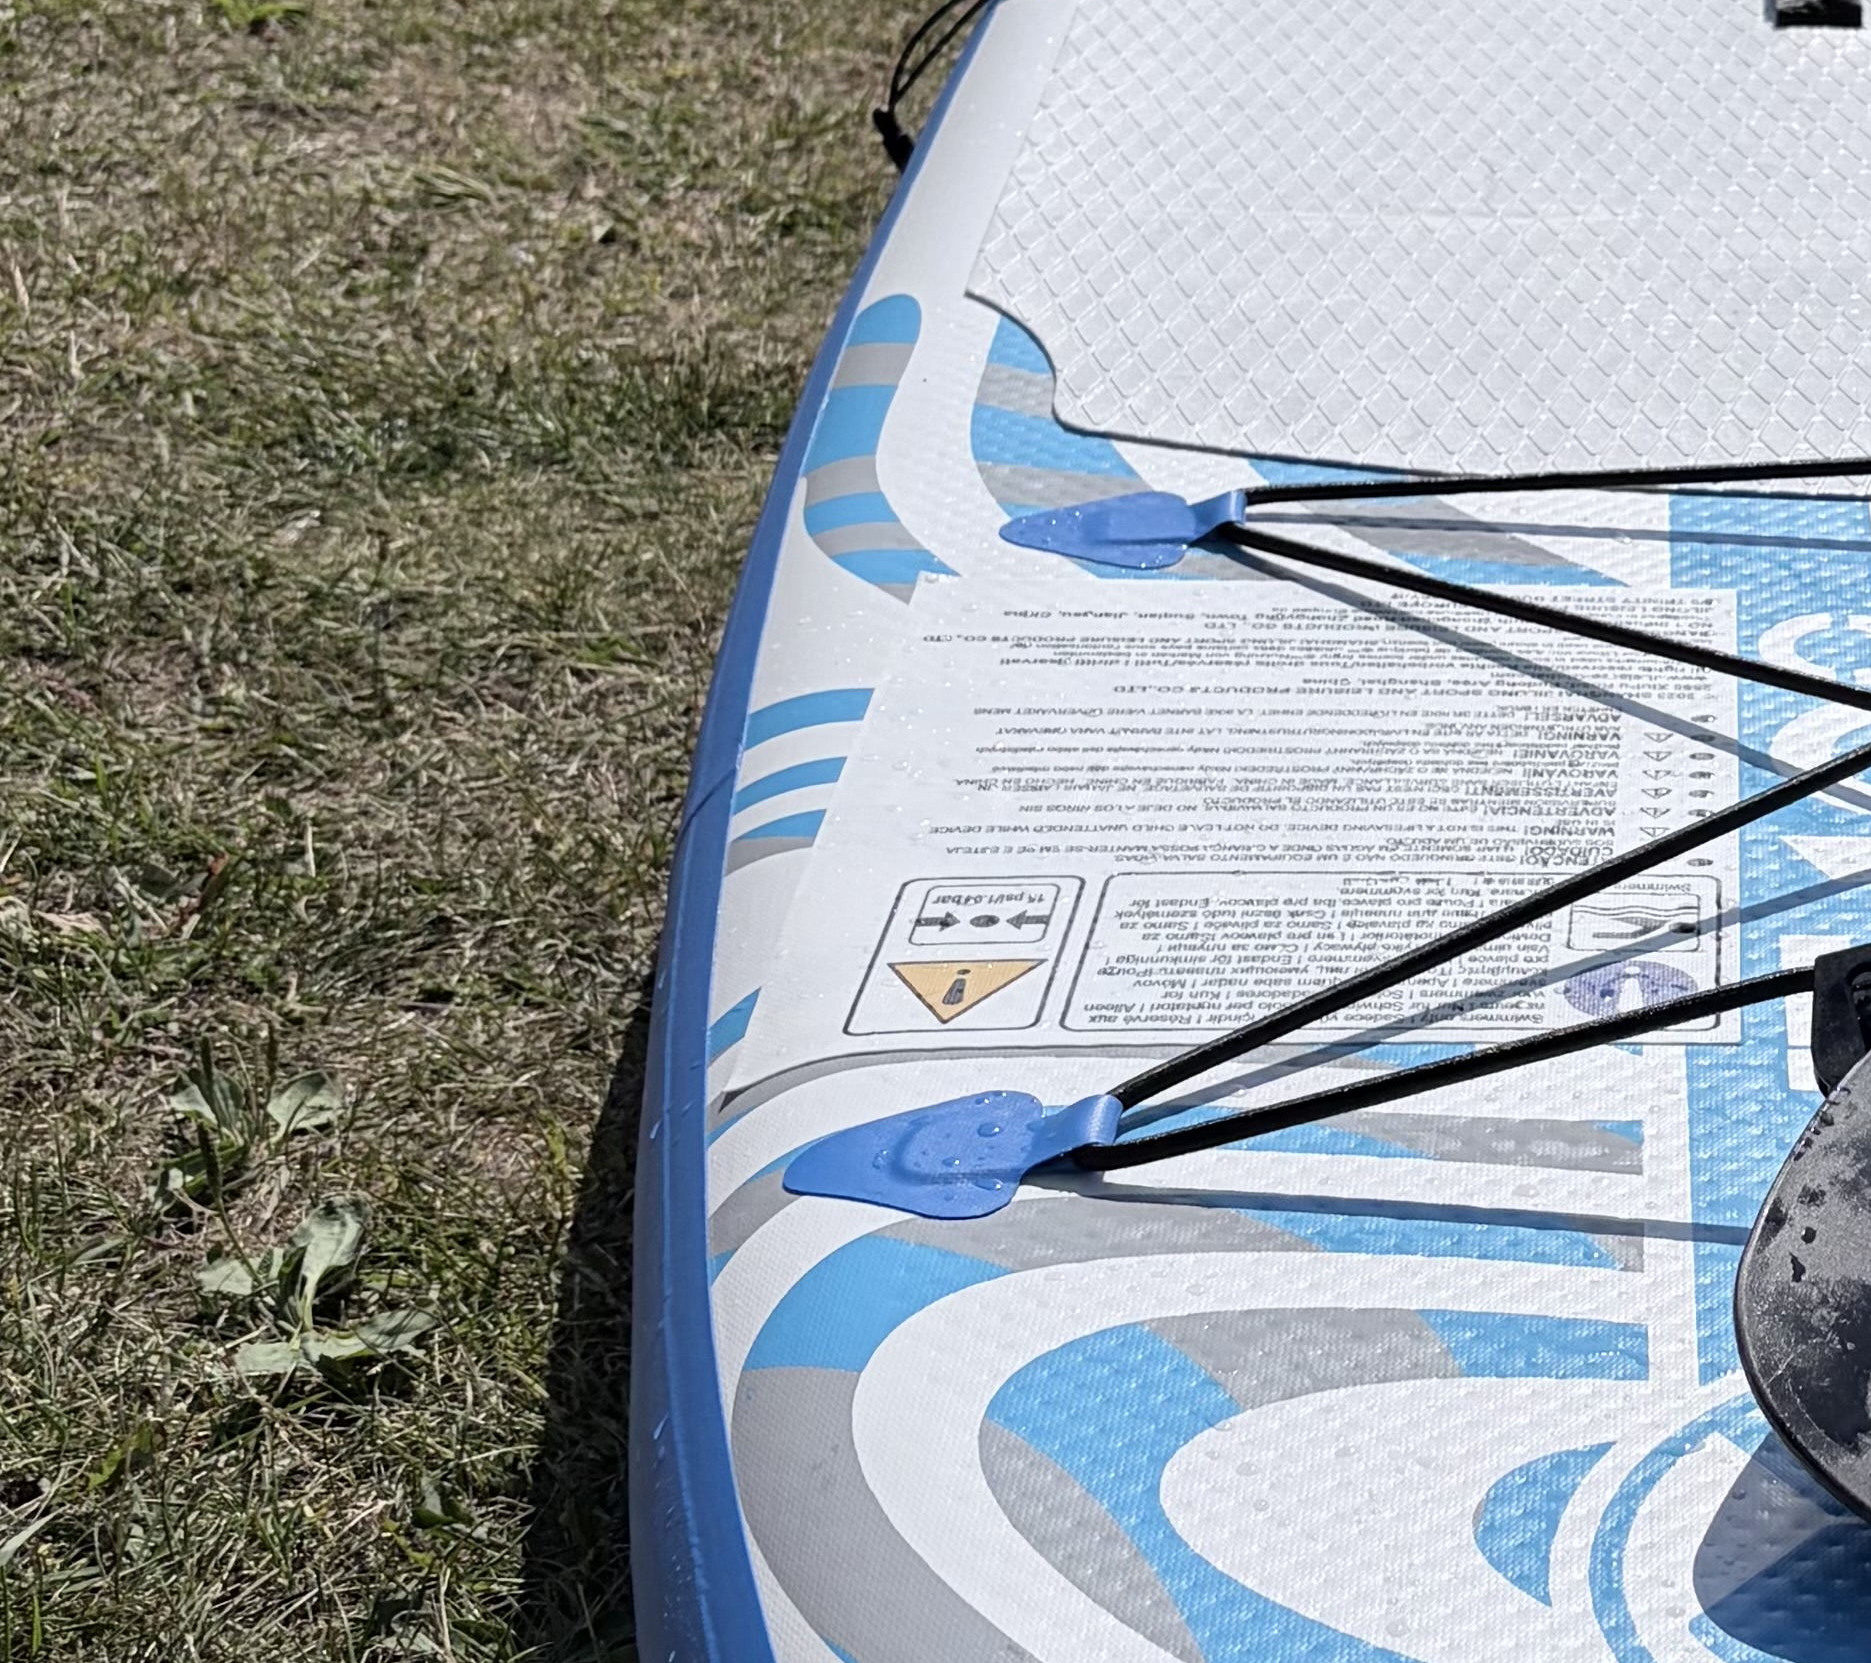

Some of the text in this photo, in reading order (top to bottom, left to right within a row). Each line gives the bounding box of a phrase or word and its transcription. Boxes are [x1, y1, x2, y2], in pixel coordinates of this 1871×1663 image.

[1536, 731, 1620, 741] VARNING!
[1483, 804, 1615, 817] ADVERTENCIA!
[1523, 824, 1615, 836] WARNING!
[1237, 955, 1292, 964] Endast
[1200, 979, 1249, 988] nadar
[1252, 979, 1293, 988] sabe
[1187, 989, 1221, 999] Kun
[1082, 1002, 1136, 1012] Alleen
[1459, 1014, 1543, 1023] Swimmers
